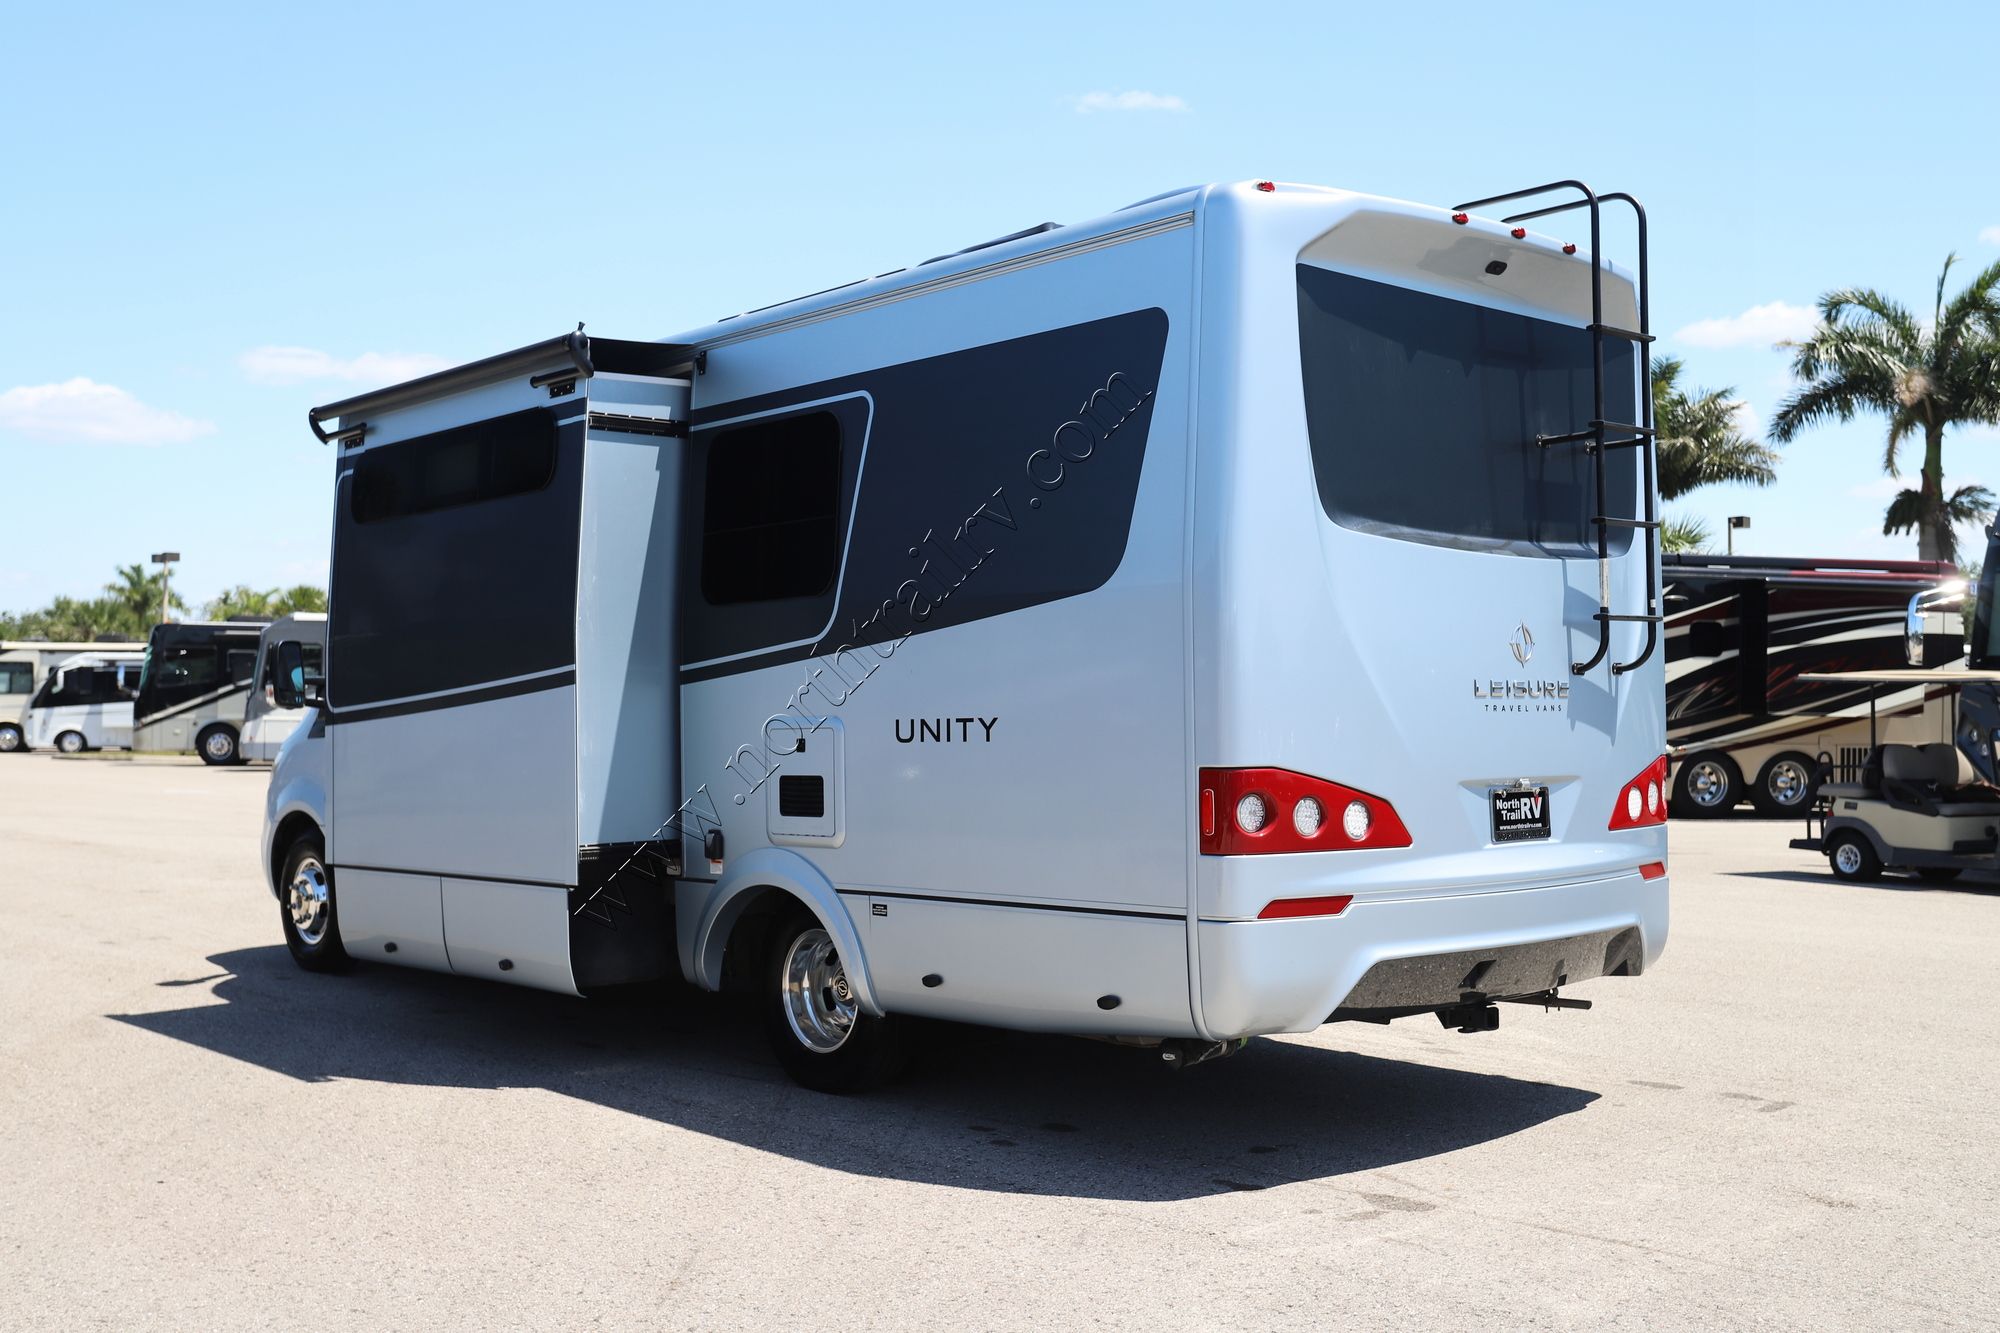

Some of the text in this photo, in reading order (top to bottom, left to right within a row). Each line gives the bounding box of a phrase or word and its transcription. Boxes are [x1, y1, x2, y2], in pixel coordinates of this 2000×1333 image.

[1473, 679, 1570, 699] LEISURE
[1484, 704, 1562, 713] TRAVEL VANS
[895, 717, 999, 744] UNITY
[1495, 798, 1520, 810] North
[1520, 796, 1543, 820] RV
[1501, 809, 1520, 821] Trail
